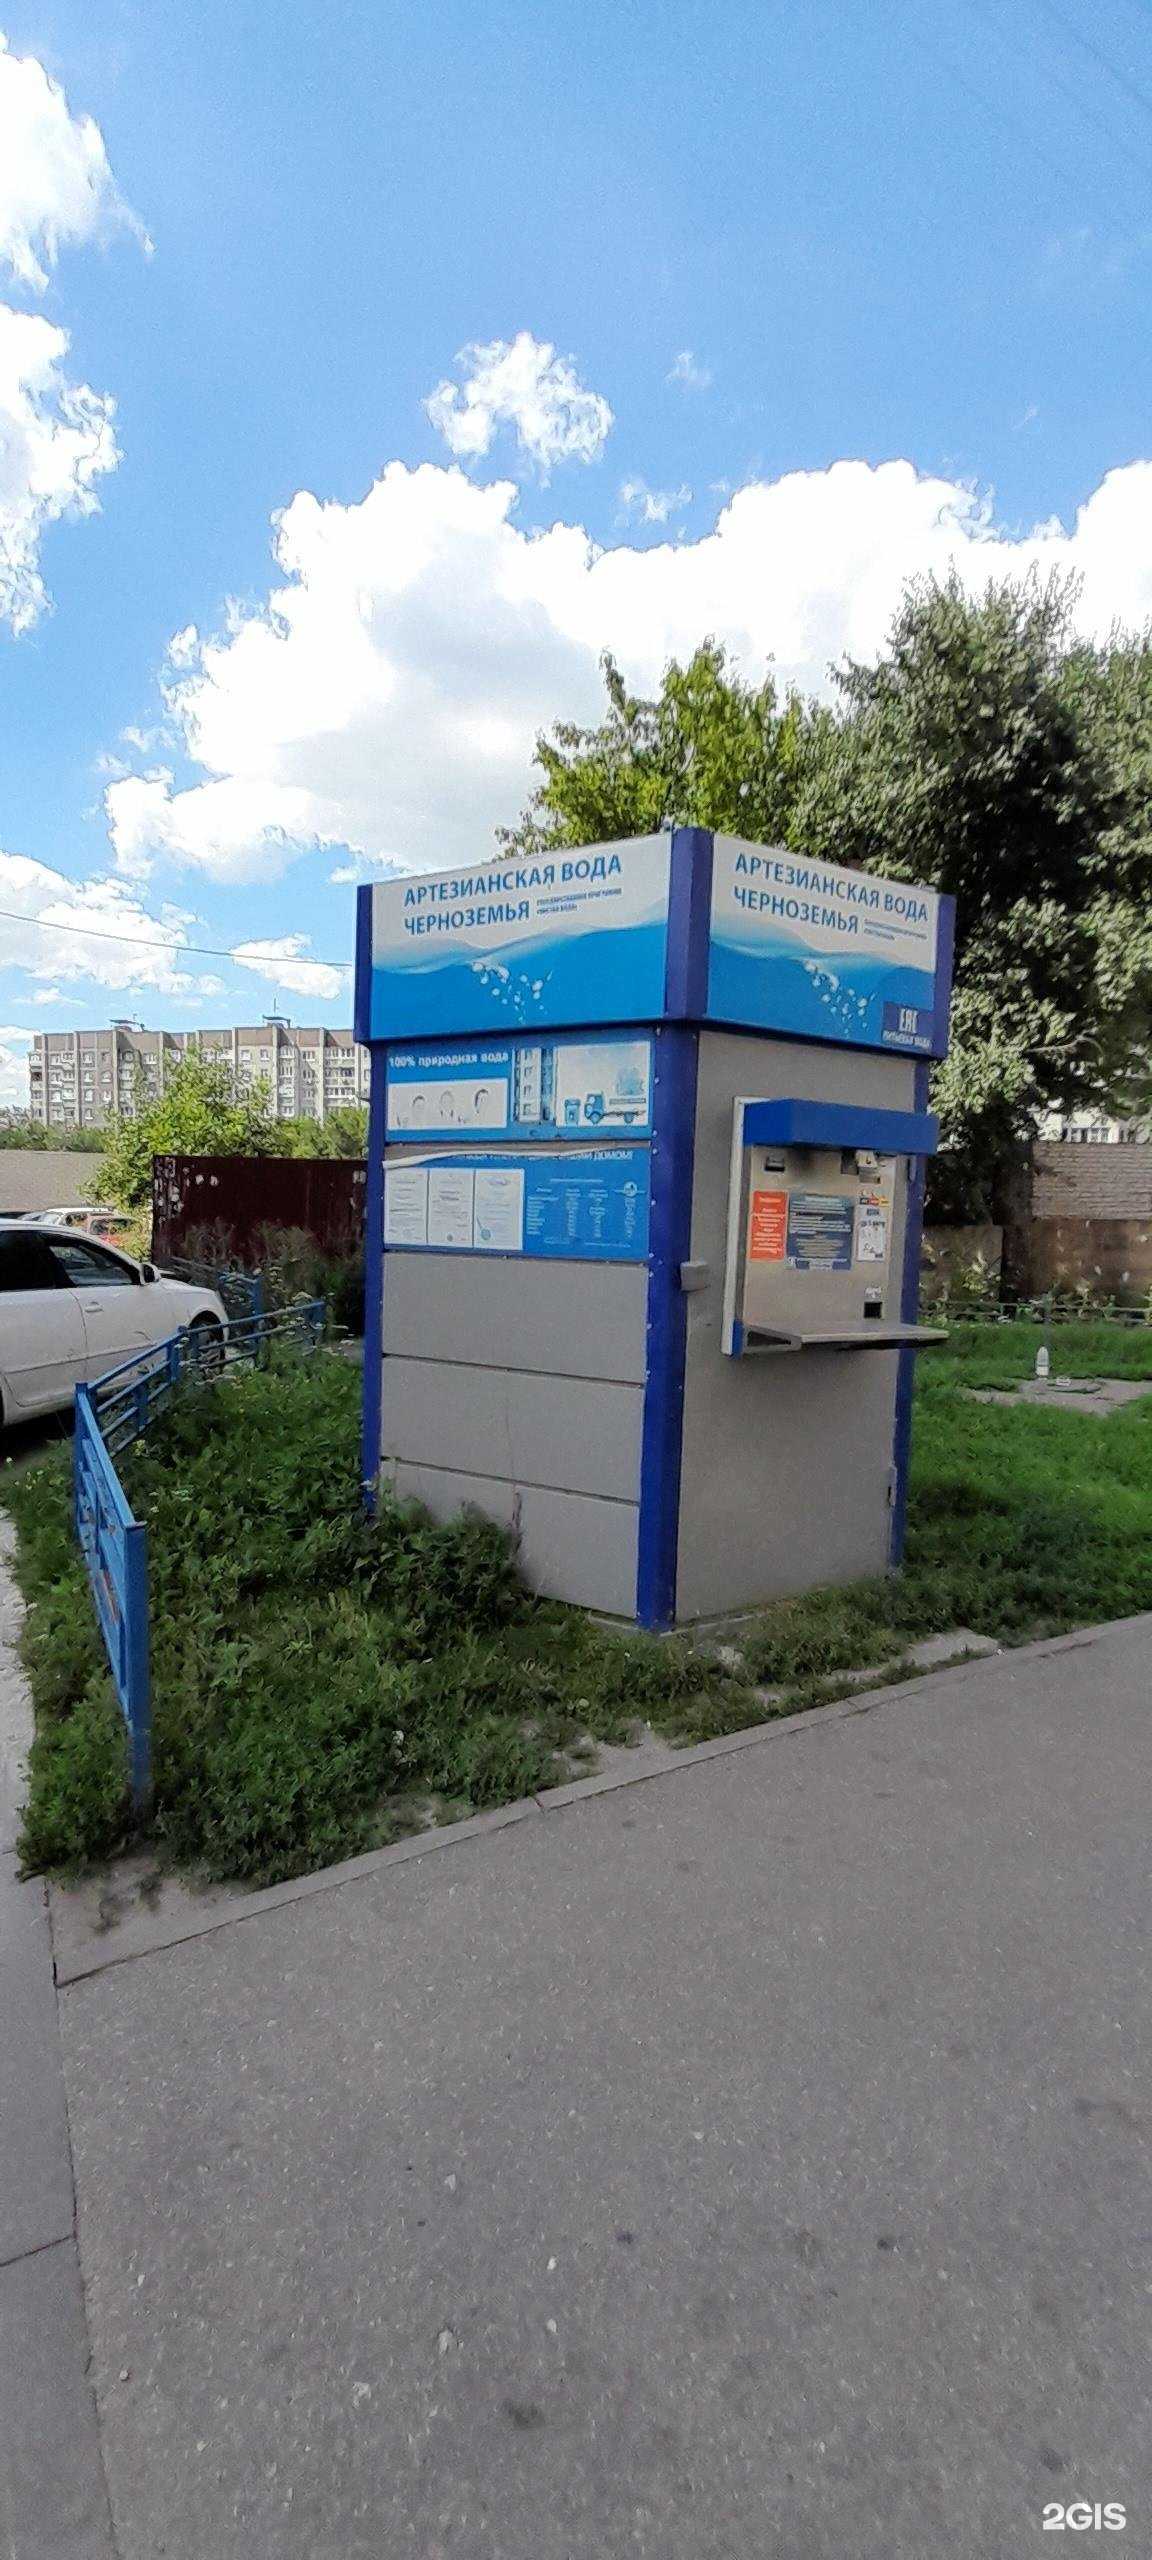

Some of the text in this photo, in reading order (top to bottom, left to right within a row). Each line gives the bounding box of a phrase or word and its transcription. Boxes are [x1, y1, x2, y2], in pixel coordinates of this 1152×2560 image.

[404, 865, 555, 907] АРТЕЗИАНСКАЯ
[562, 854, 622, 883] ВОДА
[735, 853, 929, 922] АРТЕЗИАНСКАЯ ВОДА
[404, 901, 530, 935] ЧЕРНОЗЕМЬЯ
[734, 885, 859, 934] ЧЕРНОЗЕМЬЯ
[389, 1055, 416, 1068] 100%
[481, 1051, 508, 1063] вода
